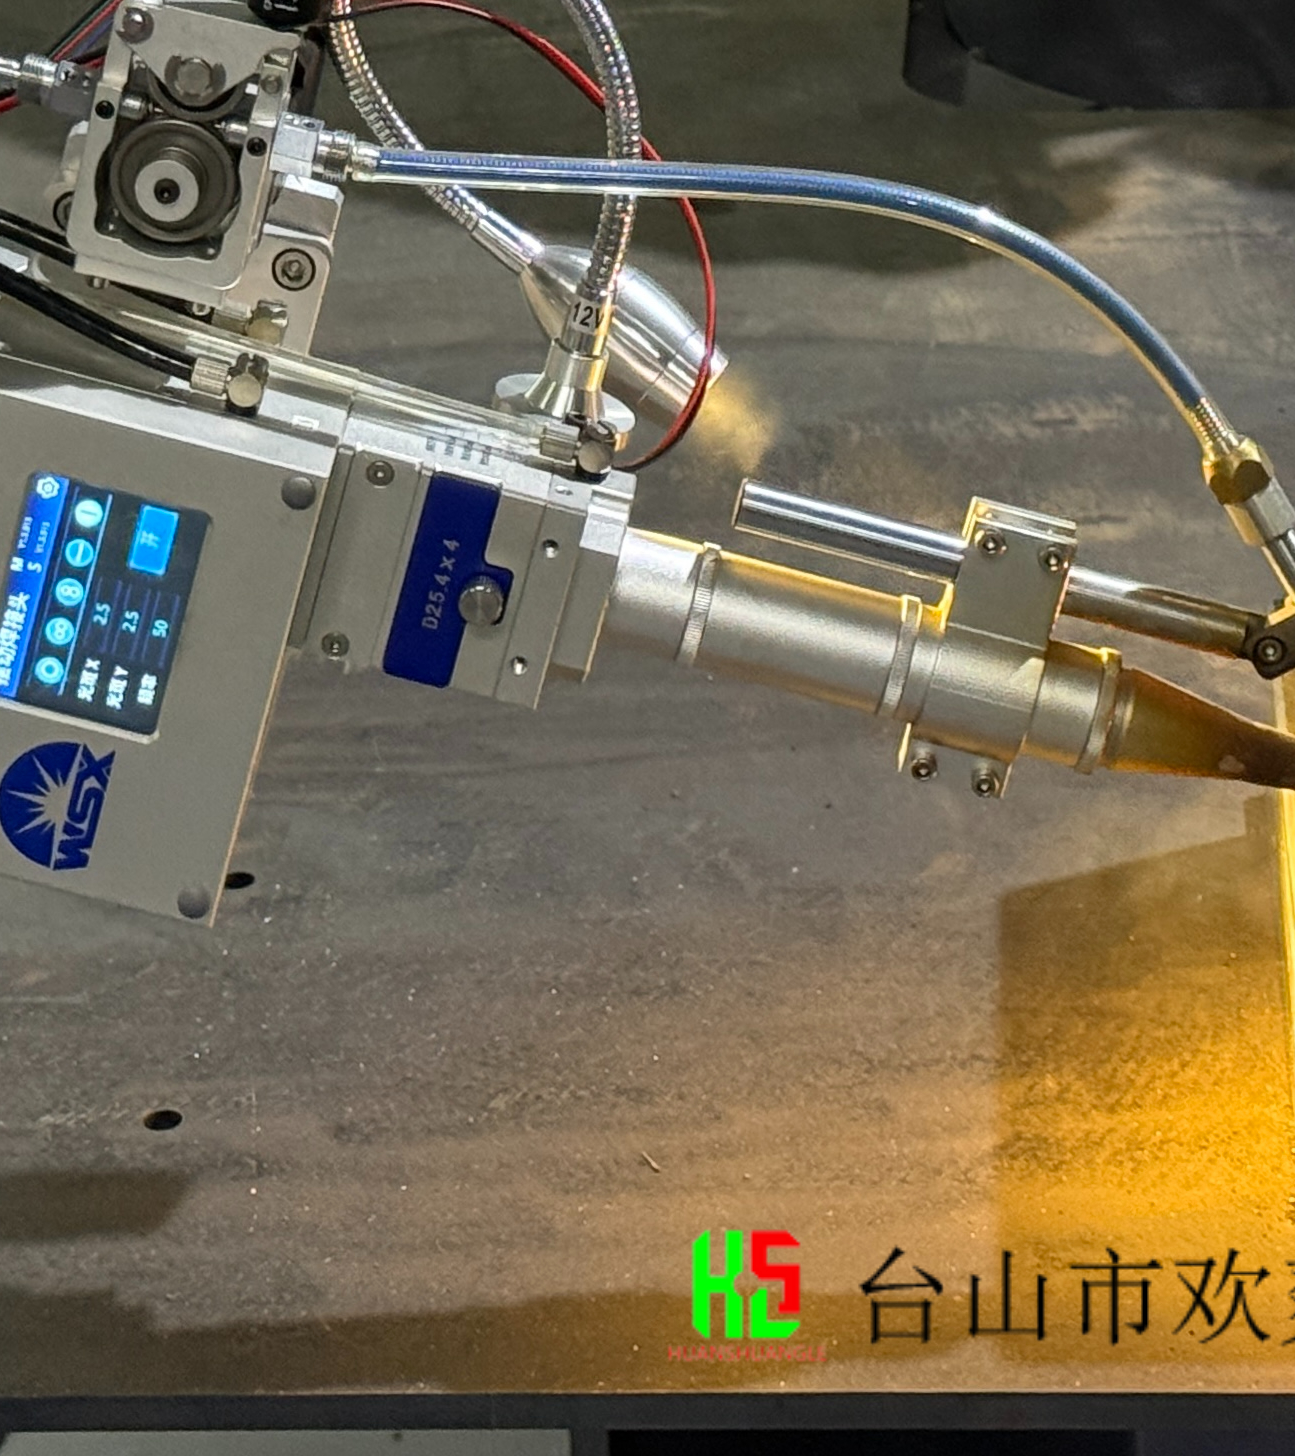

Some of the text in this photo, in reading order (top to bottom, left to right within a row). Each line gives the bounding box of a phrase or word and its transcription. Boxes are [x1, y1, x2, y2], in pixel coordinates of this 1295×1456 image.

[10, 556, 25, 573] M
[27, 561, 43, 574] S
[92, 602, 112, 627] 2.5
[121, 610, 140, 634] 2.5
[151, 619, 170, 638] 50
[52, 743, 116, 872] WSX
